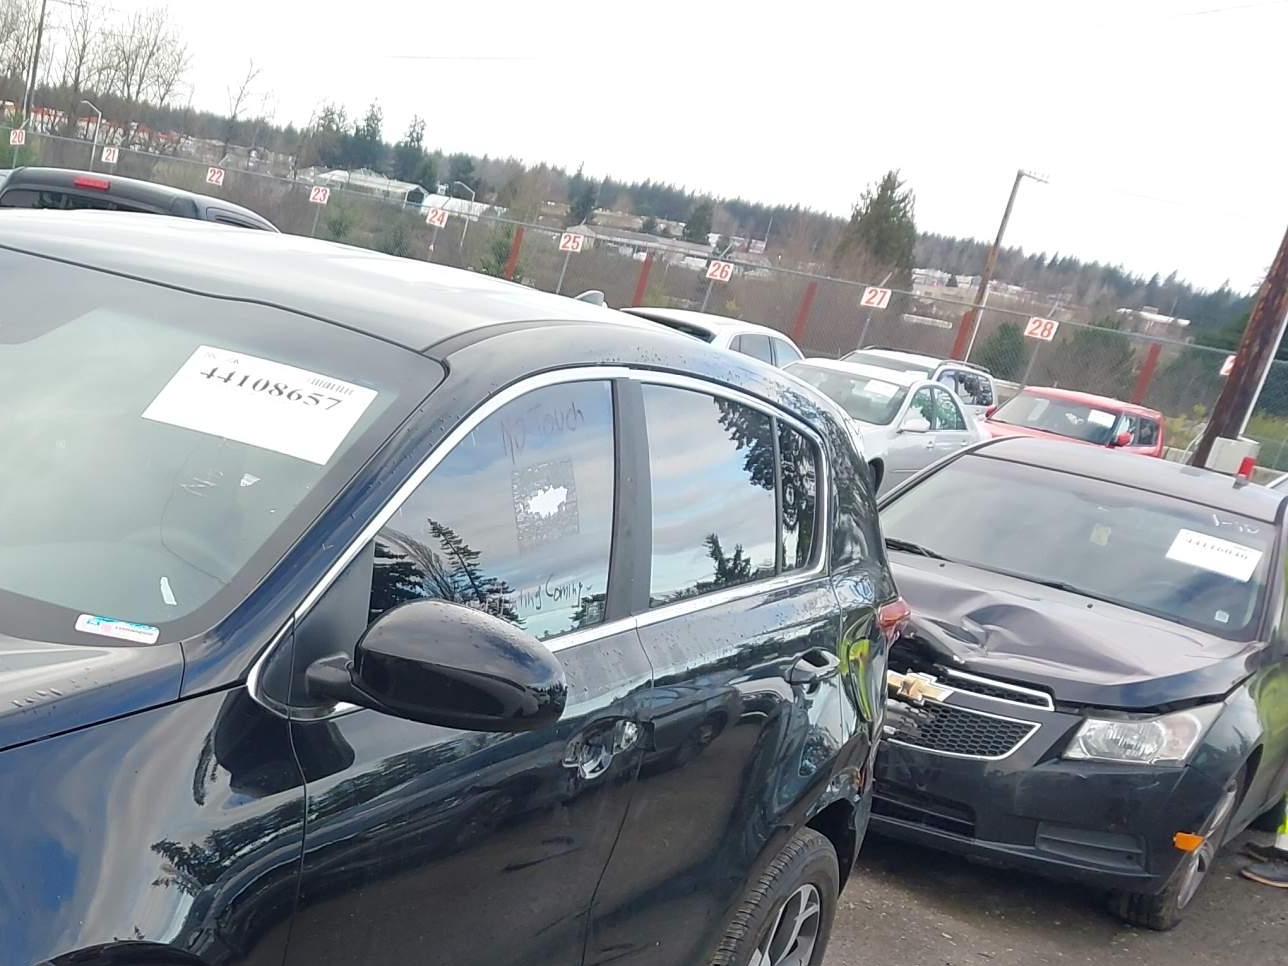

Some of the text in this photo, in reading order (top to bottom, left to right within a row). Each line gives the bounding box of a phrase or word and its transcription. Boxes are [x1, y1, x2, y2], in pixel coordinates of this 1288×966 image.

[11, 130, 24, 143] 20
[105, 149, 116, 161] 21
[208, 169, 223, 184] 22
[312, 187, 328, 202] 23
[428, 209, 445, 224] 24
[562, 235, 582, 250] 25
[709, 262, 729, 278] 26
[865, 289, 889, 306] 27
[1027, 319, 1054, 338] 28
[200, 367, 343, 411] 44108657
